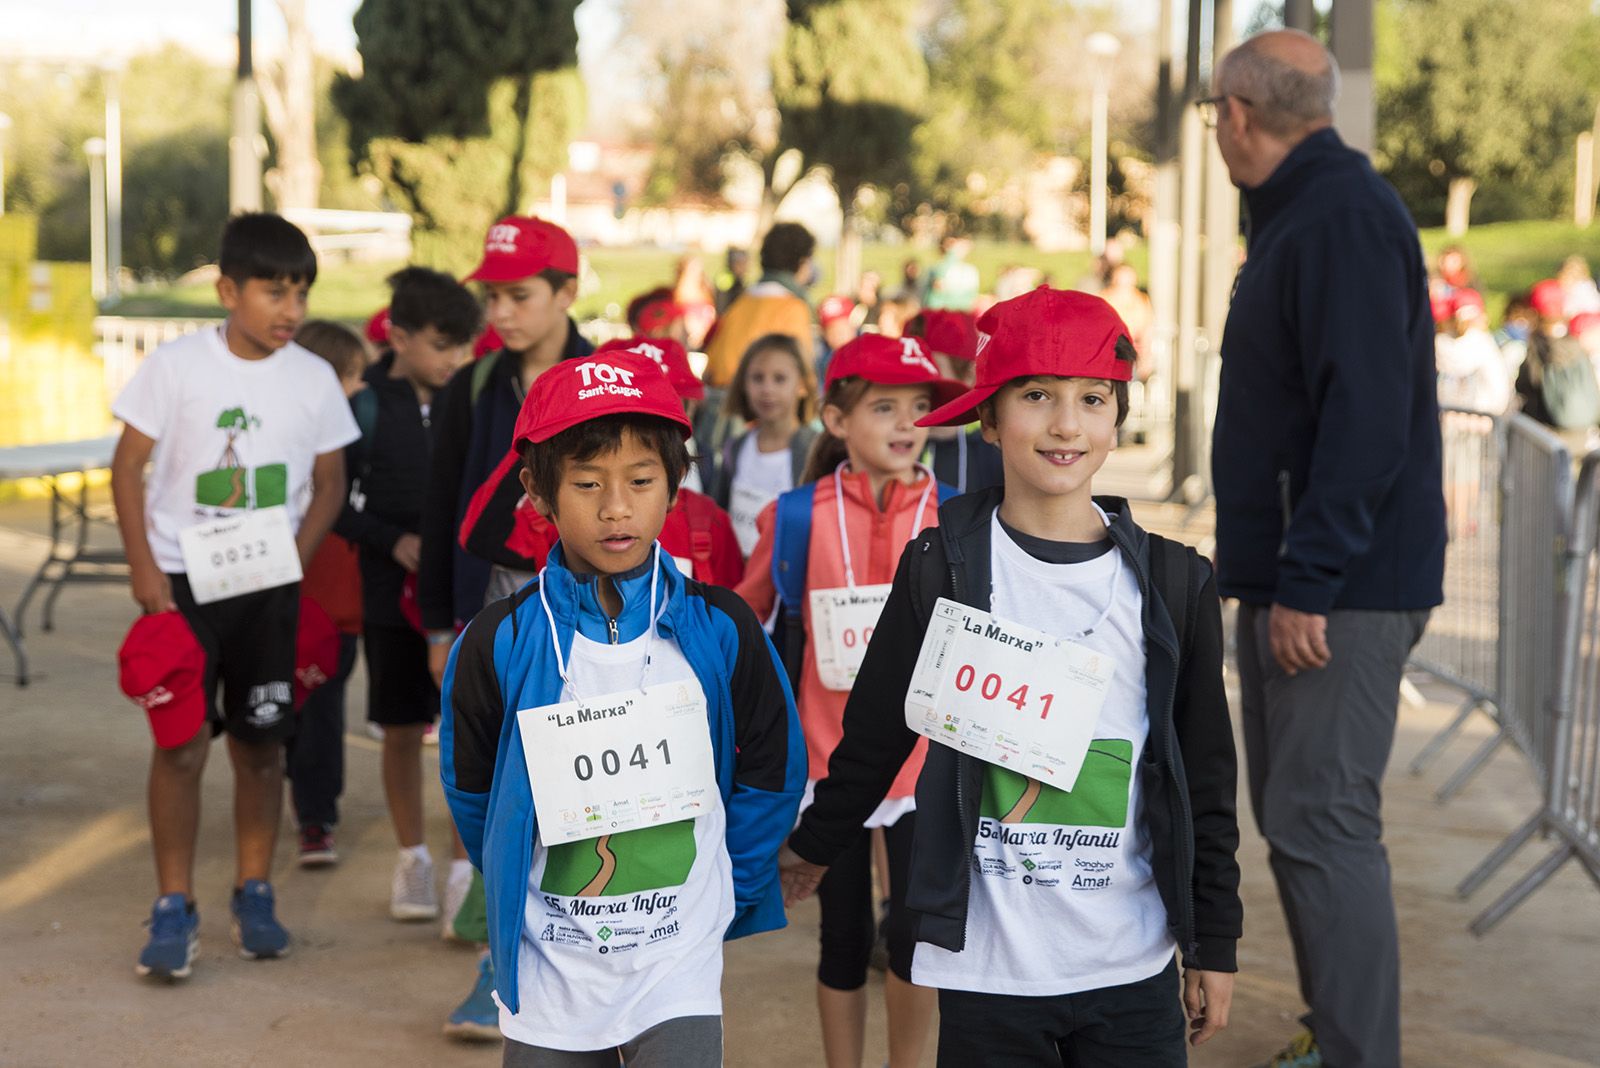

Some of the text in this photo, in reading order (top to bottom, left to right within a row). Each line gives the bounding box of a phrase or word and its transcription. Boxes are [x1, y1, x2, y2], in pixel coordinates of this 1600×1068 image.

[575, 362, 634, 387] TOT
[578, 385, 605, 400] Sant
[943, 606, 955, 617] 41
[955, 664, 1054, 720] 0041
[577, 700, 634, 724] Marxa”
[573, 738, 672, 782] 0041
[976, 821, 1120, 851] 5a Marxa Infantil
[1074, 857, 1114, 871] Sanahuja
[569, 899, 628, 917] Marxa
